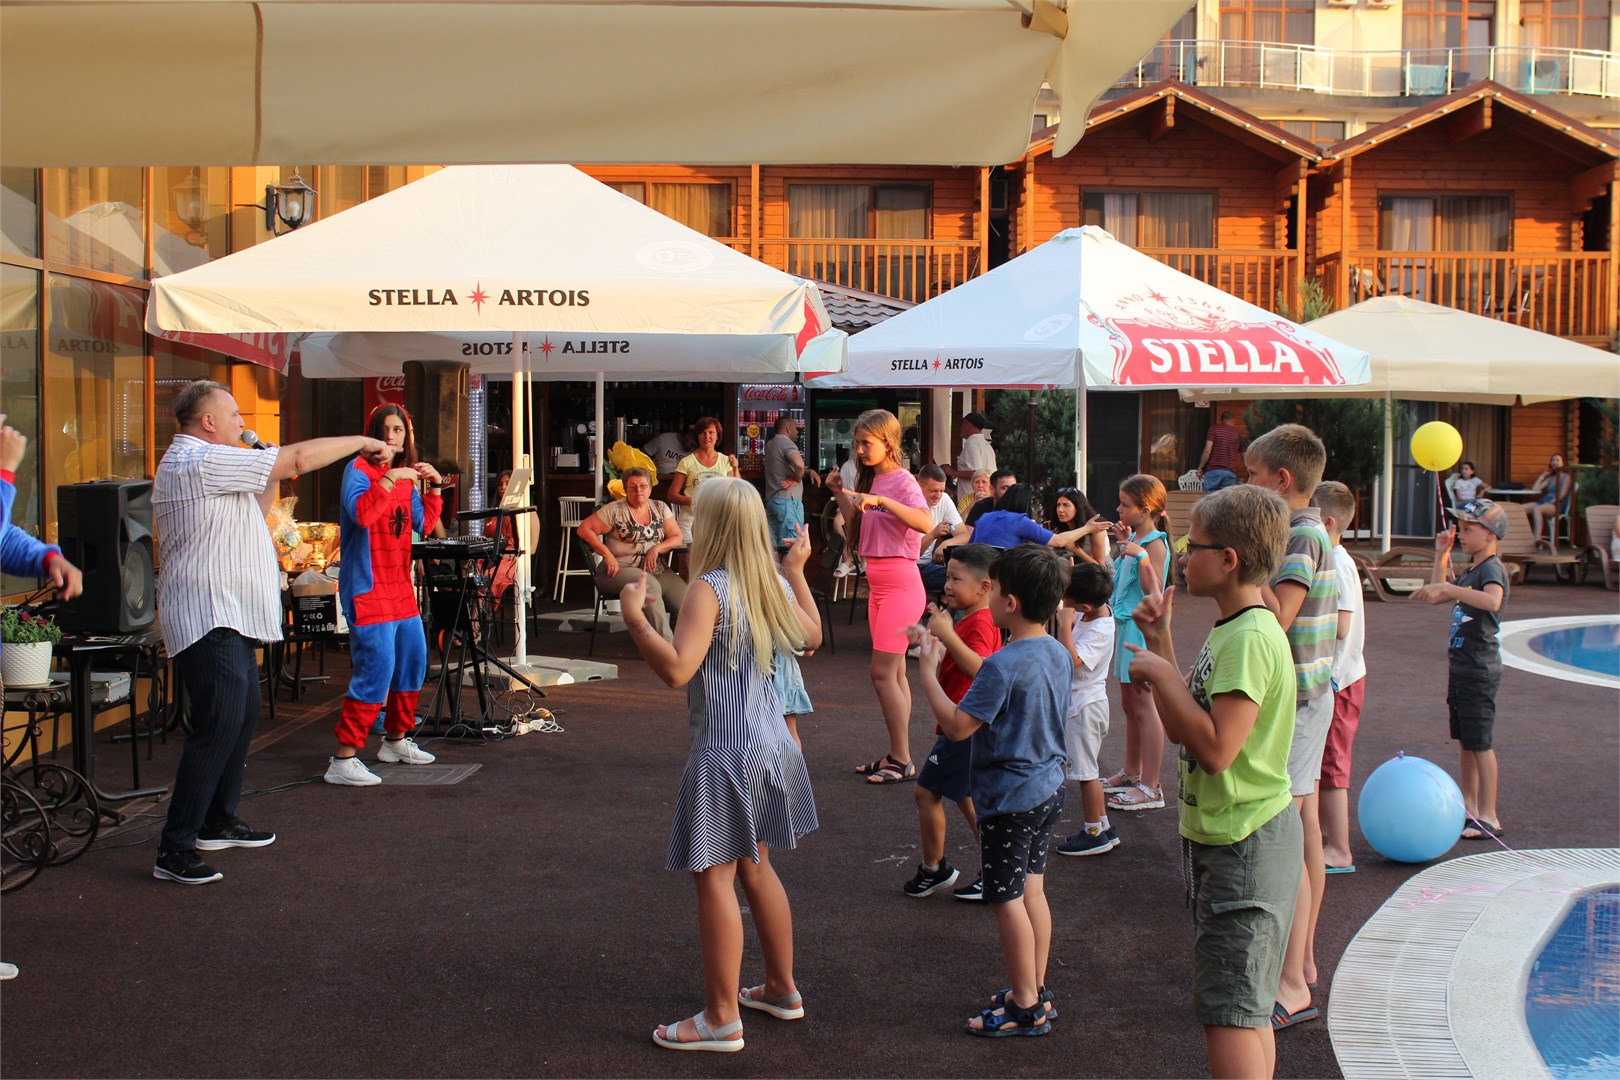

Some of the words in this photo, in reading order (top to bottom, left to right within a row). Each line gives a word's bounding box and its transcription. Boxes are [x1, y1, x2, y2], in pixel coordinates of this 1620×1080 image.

[368, 289, 458, 306] STELLA
[498, 290, 590, 306] ARTOIS
[1114, 293, 1145, 311] ANNO
[891, 359, 928, 371] STELLA
[944, 357, 984, 370] ARTOIS
[1142, 338, 1304, 373] STELLA
